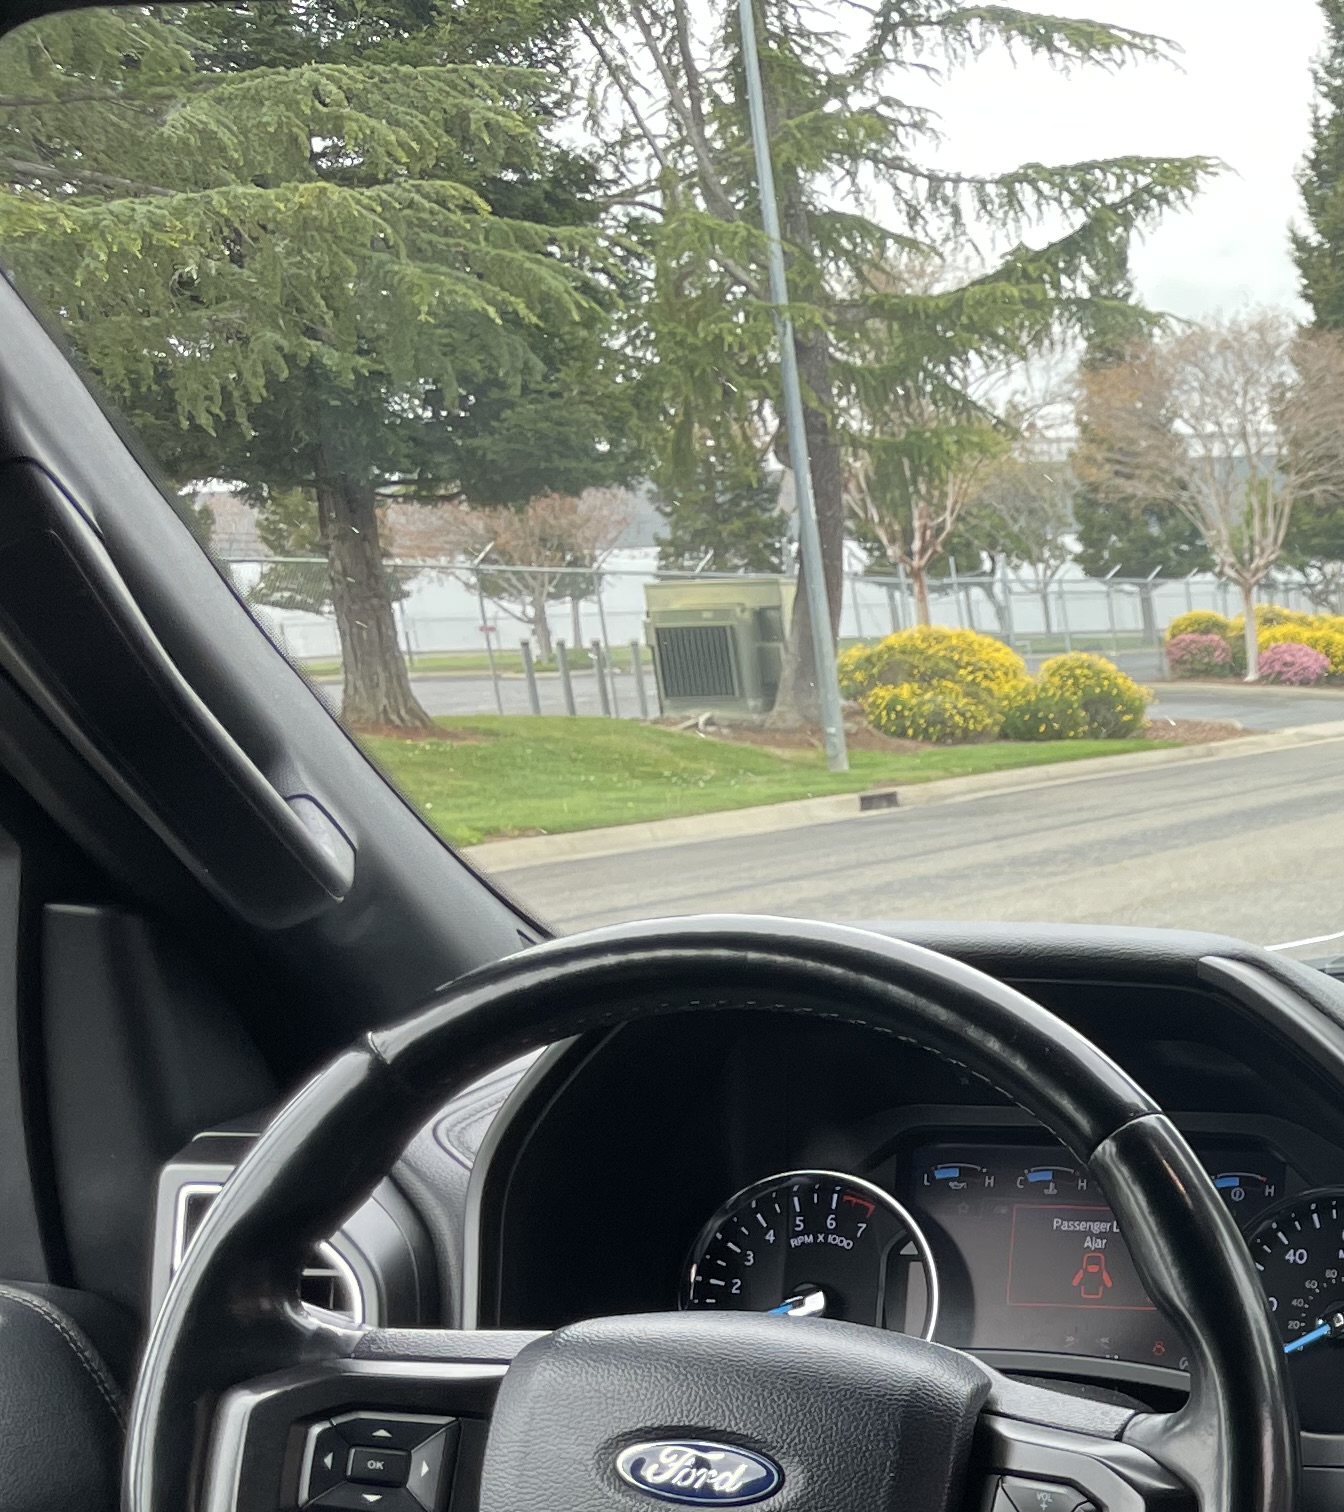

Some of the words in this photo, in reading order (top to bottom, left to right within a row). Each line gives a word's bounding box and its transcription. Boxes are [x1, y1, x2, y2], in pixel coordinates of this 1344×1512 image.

[923, 1173, 931, 1187] L
[984, 1175, 995, 1188] H
[1016, 1176, 1025, 1189] C
[1078, 1178, 1087, 1191] H
[1264, 1184, 1275, 1197] H
[794, 1216, 804, 1232] 5
[826, 1215, 836, 1230] 6
[1053, 1217, 1112, 1234] Passenger
[764, 1230, 776, 1244] 4
[857, 1222, 867, 1238] 7
[789, 1233, 814, 1248] RPM
[817, 1233, 825, 1243] X
[827, 1234, 854, 1250] 1000
[1083, 1235, 1108, 1250] Ajar
[745, 1251, 755, 1266] 3
[1285, 1248, 1308, 1264] 40
[1325, 1269, 1338, 1278] 80
[731, 1278, 742, 1294] 2
[1305, 1280, 1318, 1289] 60
[1291, 1298, 1304, 1307] 40
[1288, 1320, 1300, 1329] 20
[367, 1459, 384, 1470] OK
[641, 1446, 746, 1493] Ford
[1036, 1491, 1053, 1503] VOL
